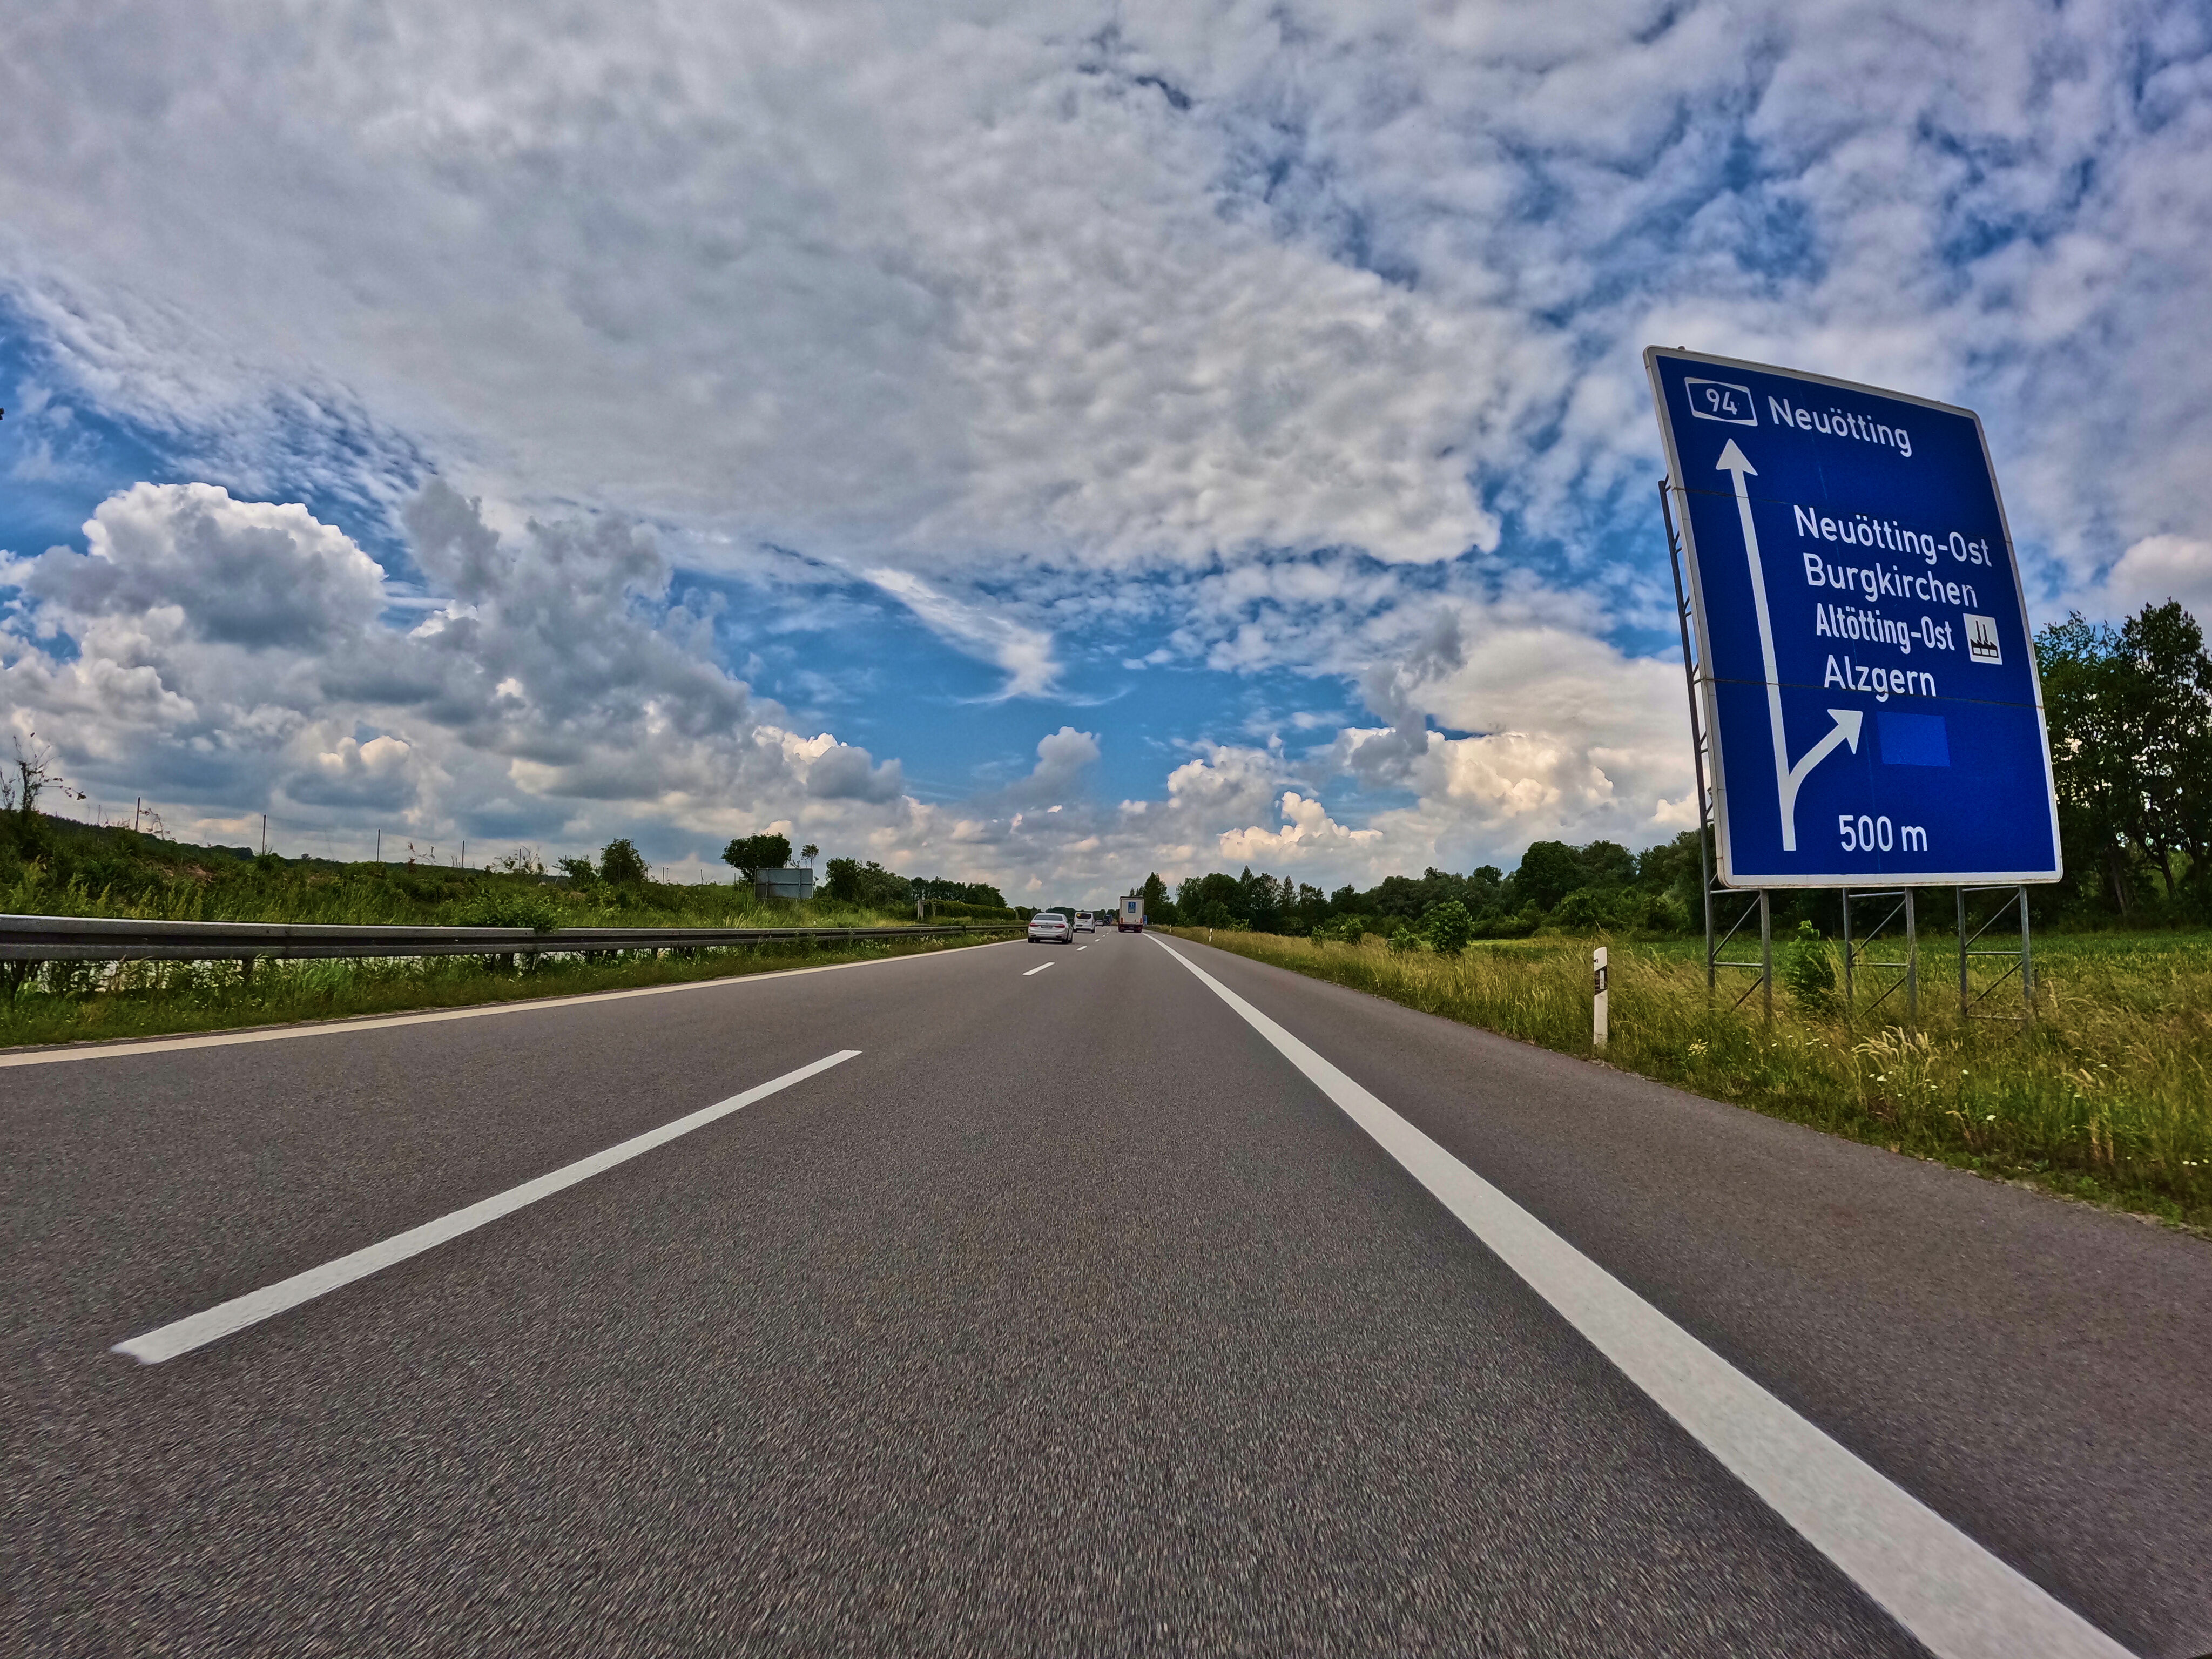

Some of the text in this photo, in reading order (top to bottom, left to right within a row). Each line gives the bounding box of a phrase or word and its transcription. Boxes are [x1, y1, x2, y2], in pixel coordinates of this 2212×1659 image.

[1705, 388, 1737, 415] 94
[1768, 396, 1912, 458] Neuötting
[1793, 504, 1992, 567] Neuötting-Ost
[1803, 552, 1978, 609] Burgkirchen
[1816, 602, 1955, 655] Altötting-Ost
[1823, 654, 1937, 703] Alzgern
[1838, 814, 1928, 852] 500 m
